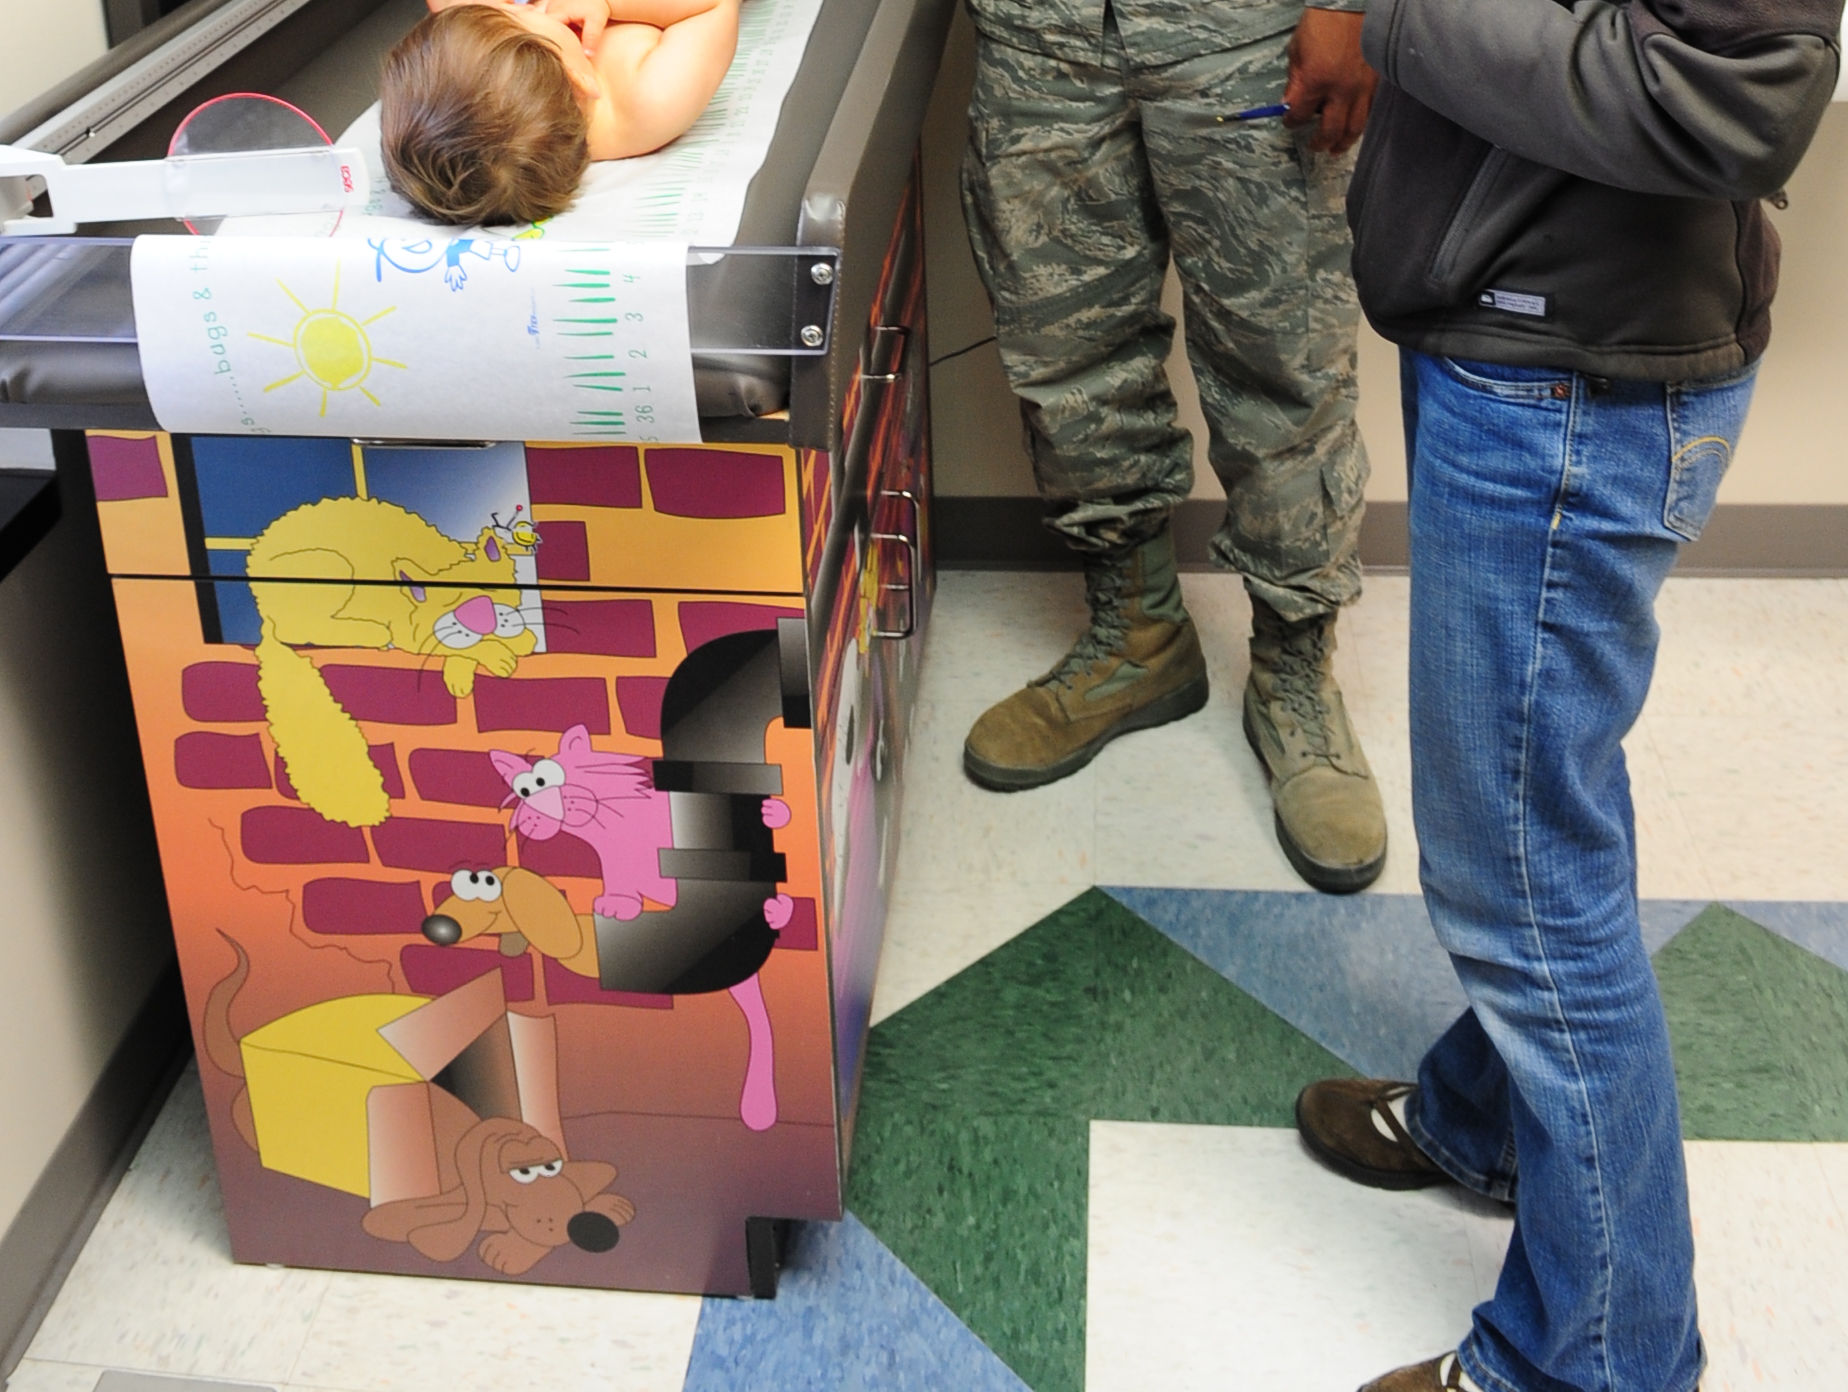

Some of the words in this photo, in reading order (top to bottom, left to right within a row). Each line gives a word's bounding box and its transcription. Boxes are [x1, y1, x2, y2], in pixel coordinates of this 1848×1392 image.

[622, 273, 641, 283] 4
[192, 288, 212, 300] &
[625, 312, 644, 322] 3
[203, 311, 232, 375] bugs
[628, 349, 648, 359] 2
[635, 405, 655, 424] 36
